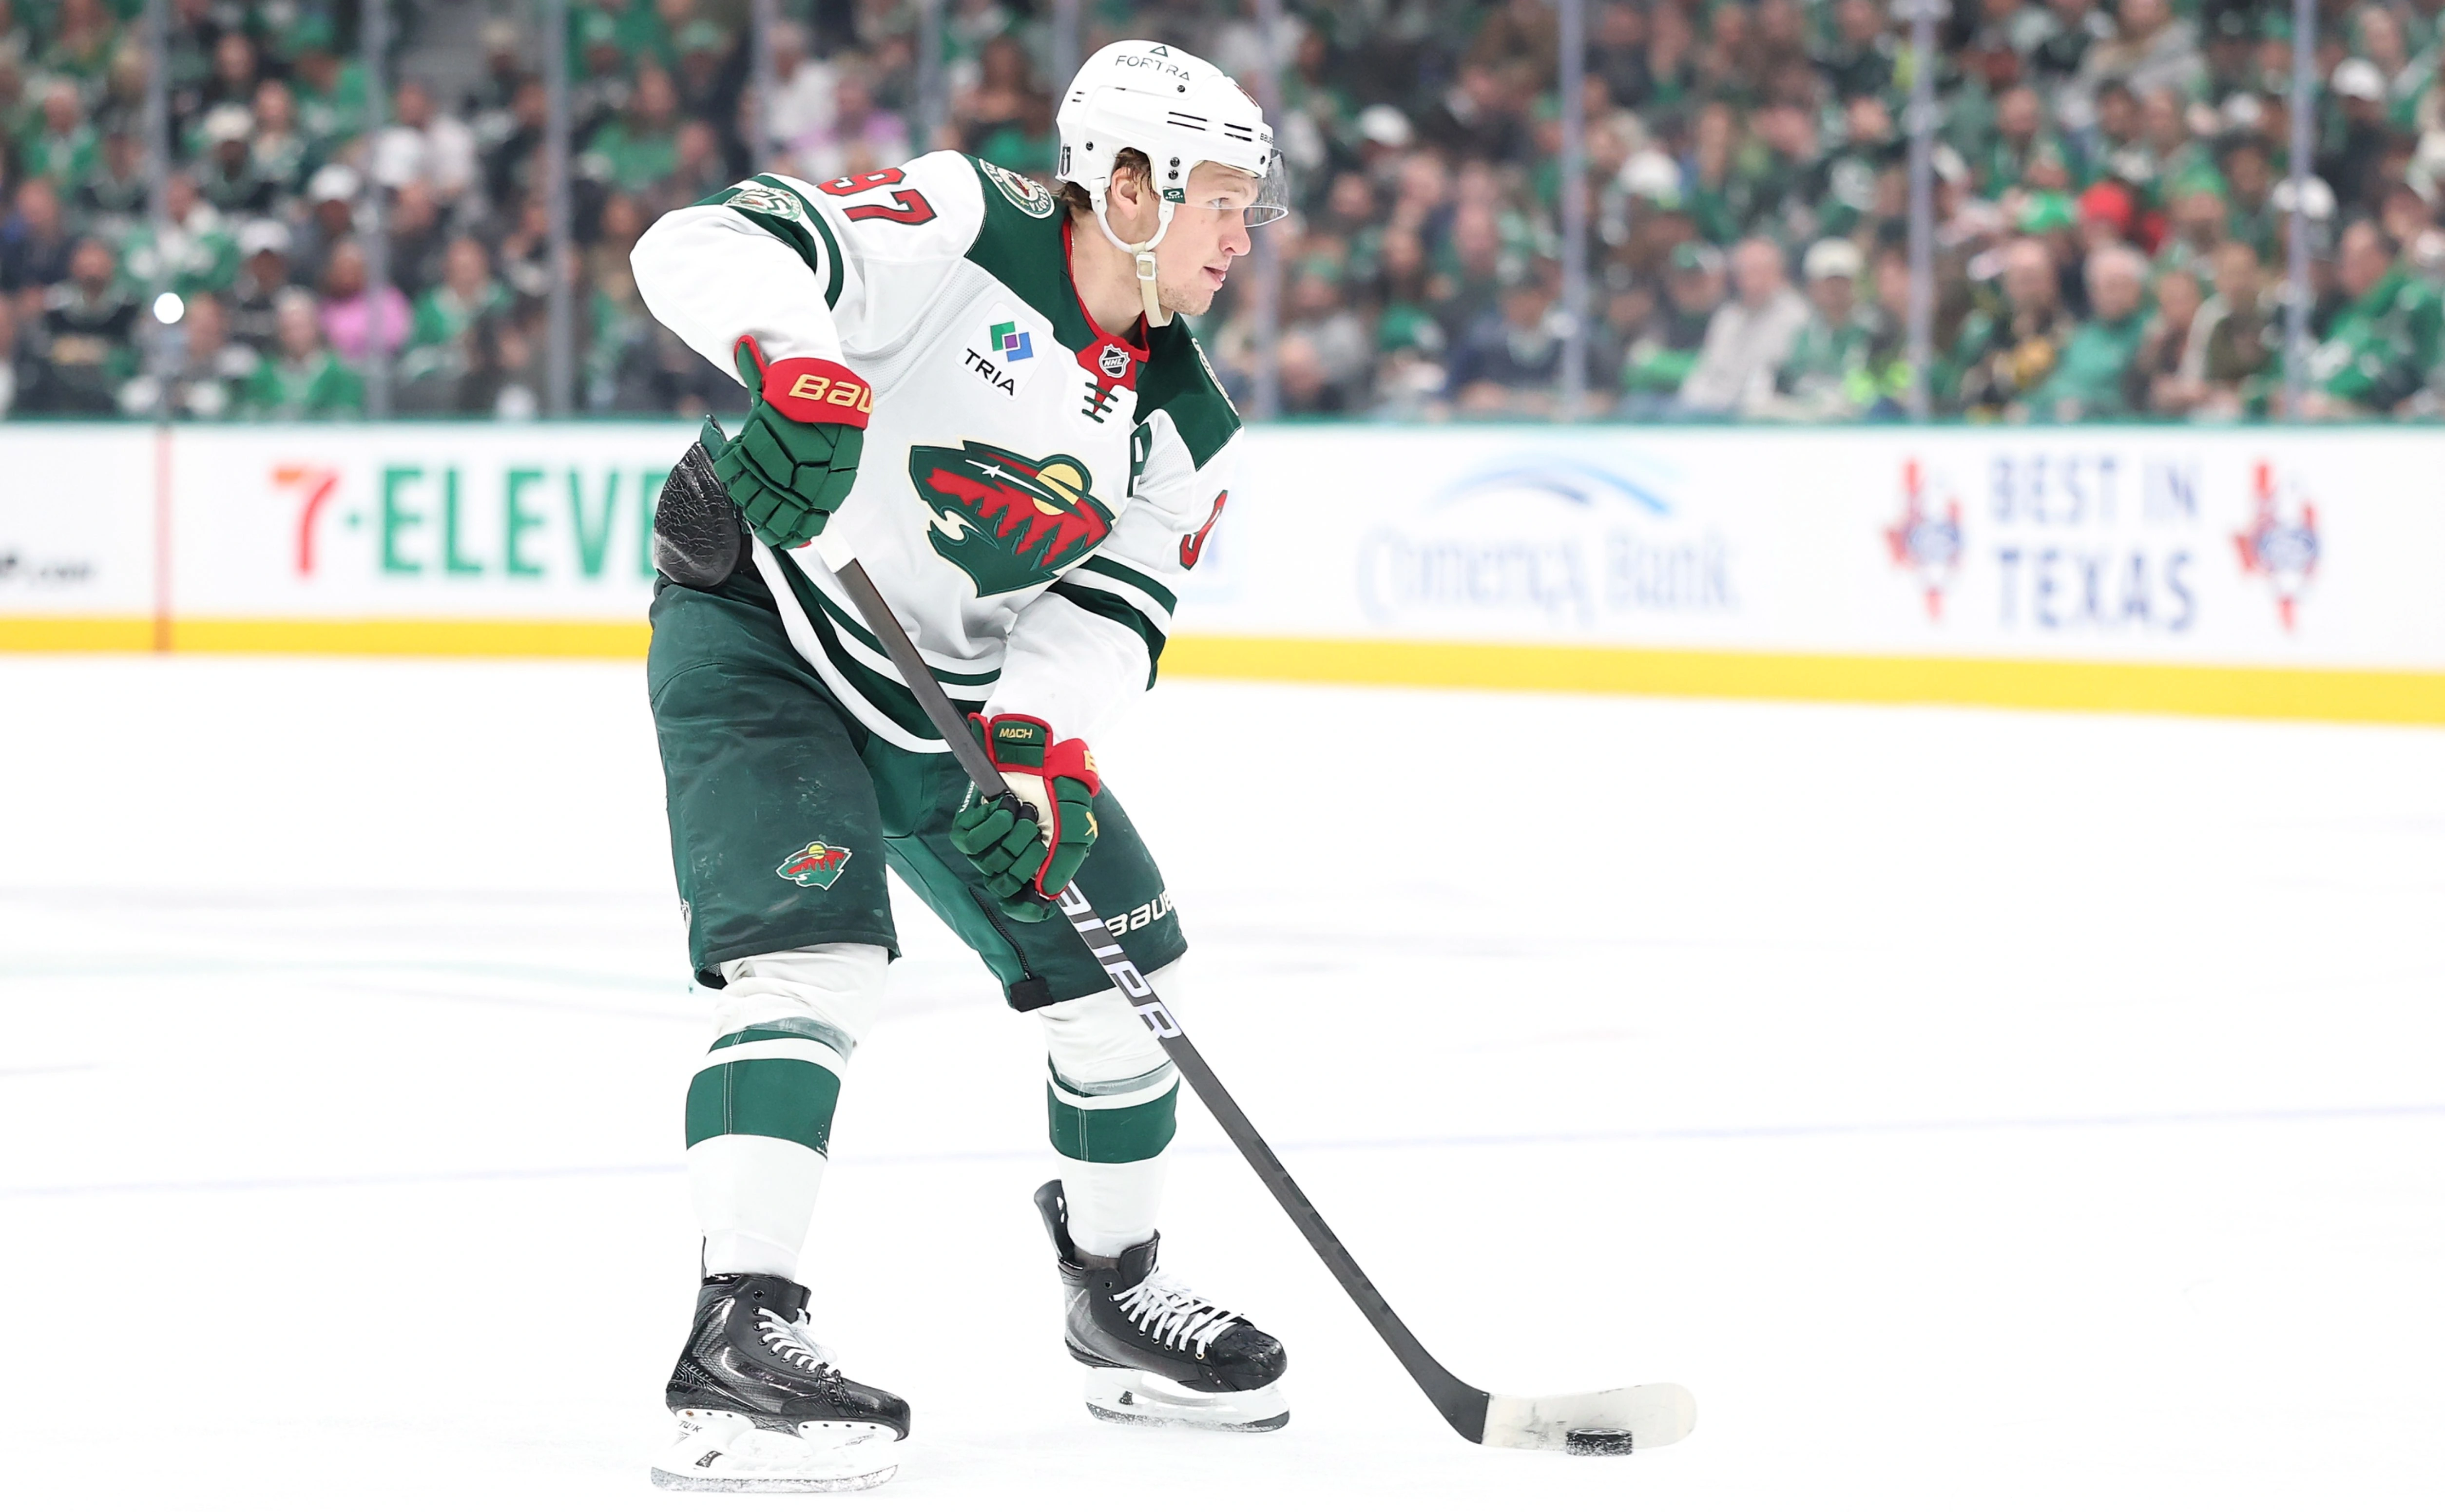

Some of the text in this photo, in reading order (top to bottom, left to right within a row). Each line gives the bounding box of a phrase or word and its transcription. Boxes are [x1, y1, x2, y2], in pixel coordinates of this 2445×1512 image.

[1115, 55, 1190, 81] FORTRA
[816, 167, 938, 226] 97
[964, 347, 1015, 396] TRIA
[1104, 358, 1123, 367] NHL
[1988, 456, 2204, 528] BEST IN
[1996, 546, 2201, 635] TEXAS
[999, 727, 1033, 739] MACH
